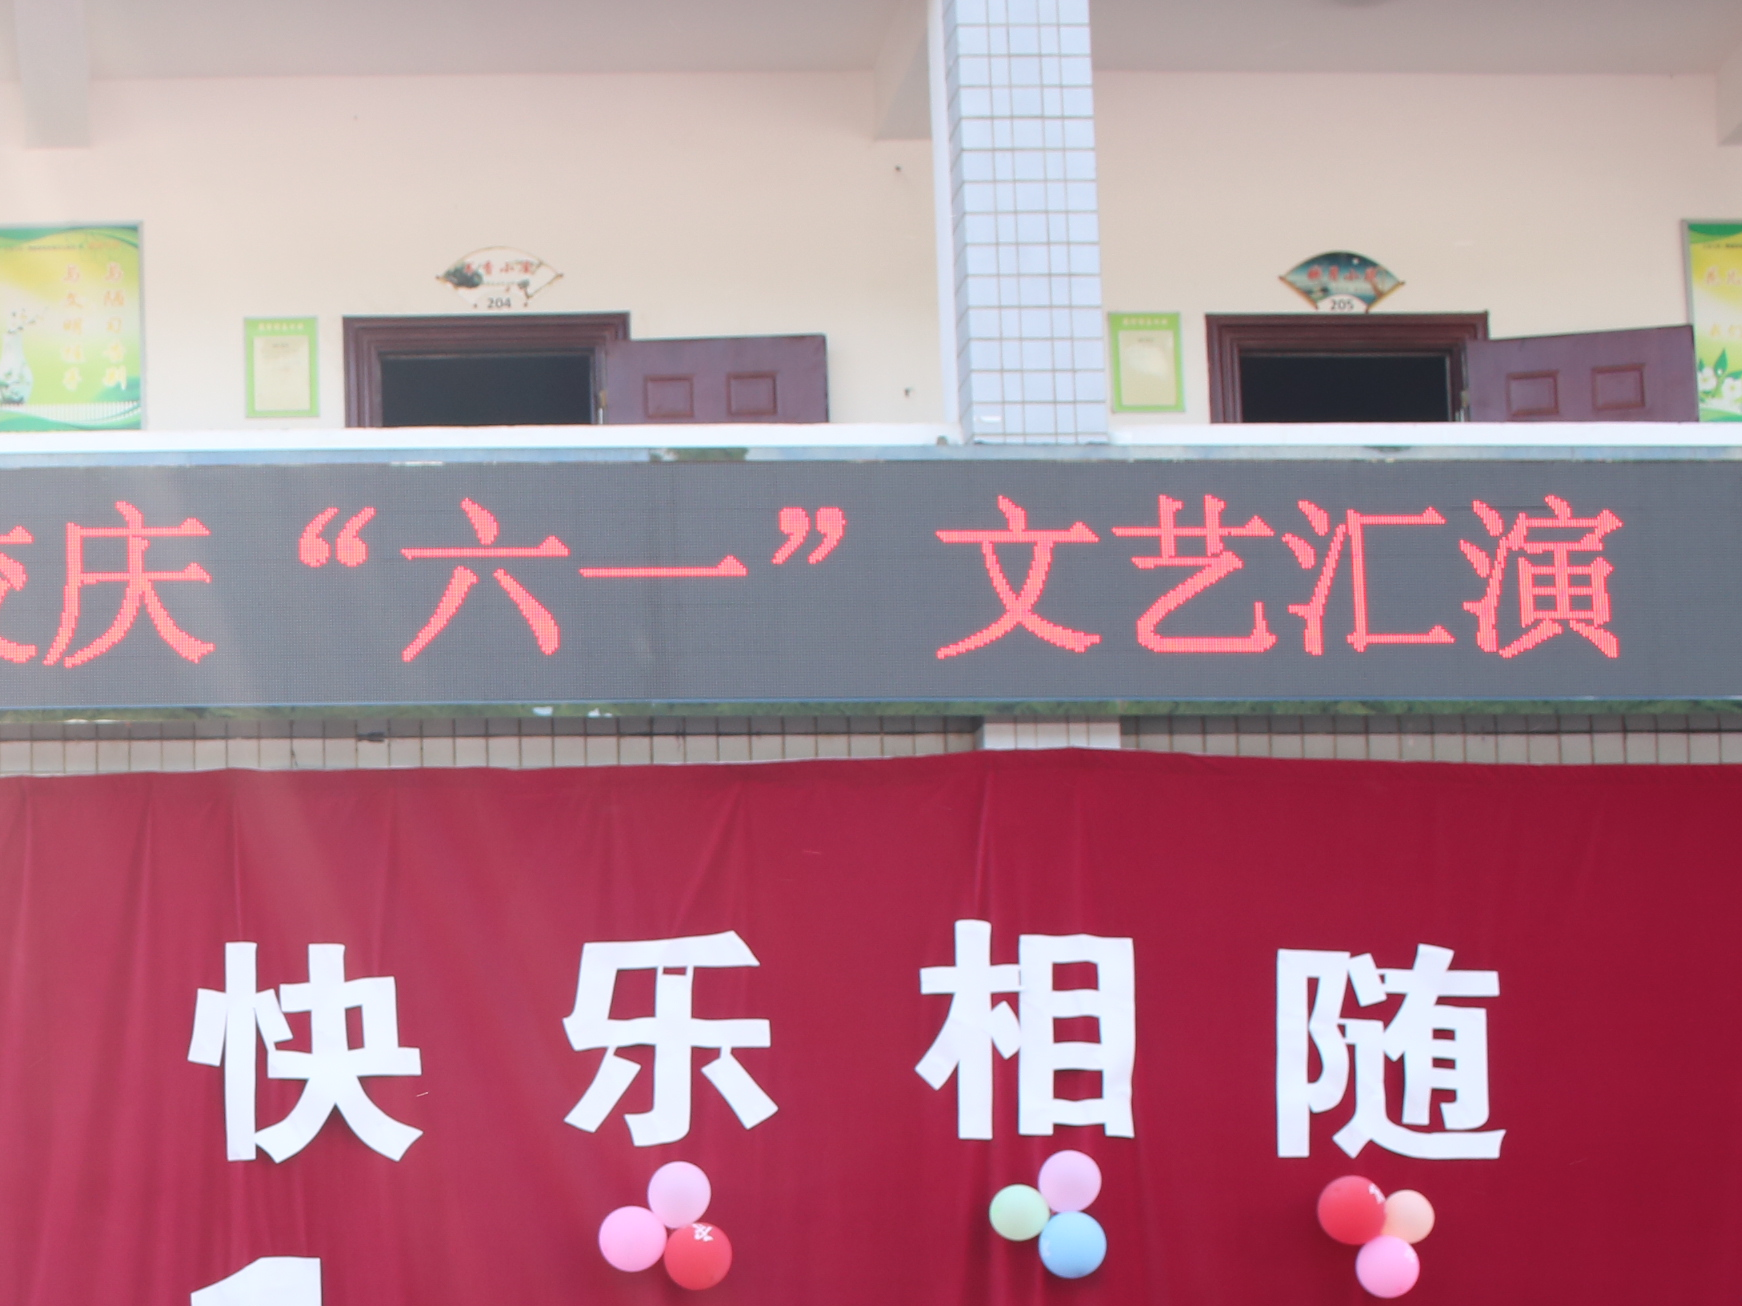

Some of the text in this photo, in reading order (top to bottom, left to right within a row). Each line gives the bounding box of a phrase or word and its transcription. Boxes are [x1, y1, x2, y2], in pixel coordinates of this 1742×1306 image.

[486, 296, 512, 309] 204
[1330, 298, 1355, 311] 205
[188, 920, 1506, 1162] 快乐相随
